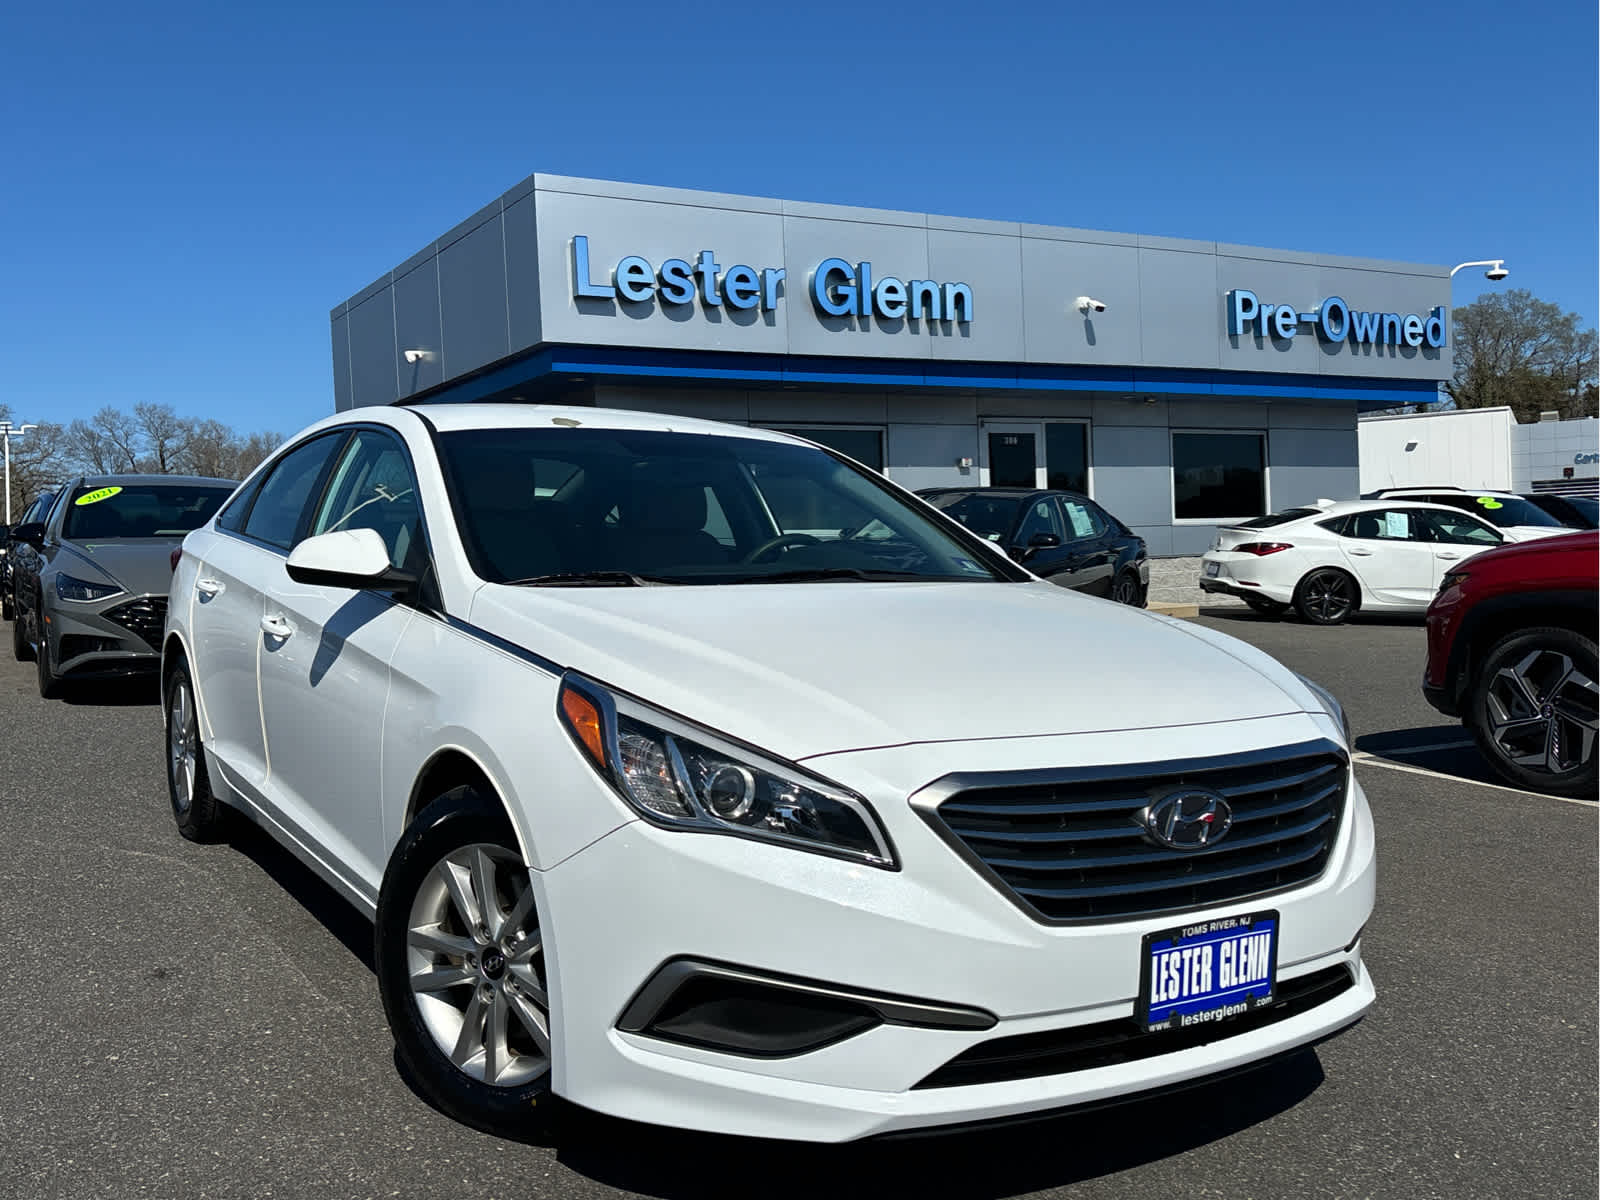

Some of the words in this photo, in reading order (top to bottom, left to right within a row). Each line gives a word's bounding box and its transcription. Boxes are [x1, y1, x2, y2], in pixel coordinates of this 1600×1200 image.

[571, 235, 785, 312] Lester
[812, 257, 974, 323] Glenn
[1227, 289, 1447, 348] Pre-Owned
[87, 487, 113, 503] 2021
[1182, 924, 1208, 938] TOMS
[1240, 916, 1251, 926] NJ
[1151, 945, 1213, 1004] LESTER
[1219, 933, 1271, 989] GLENN
[1180, 1002, 1248, 1027] lesterglenn
[1254, 996, 1273, 1008] .com
